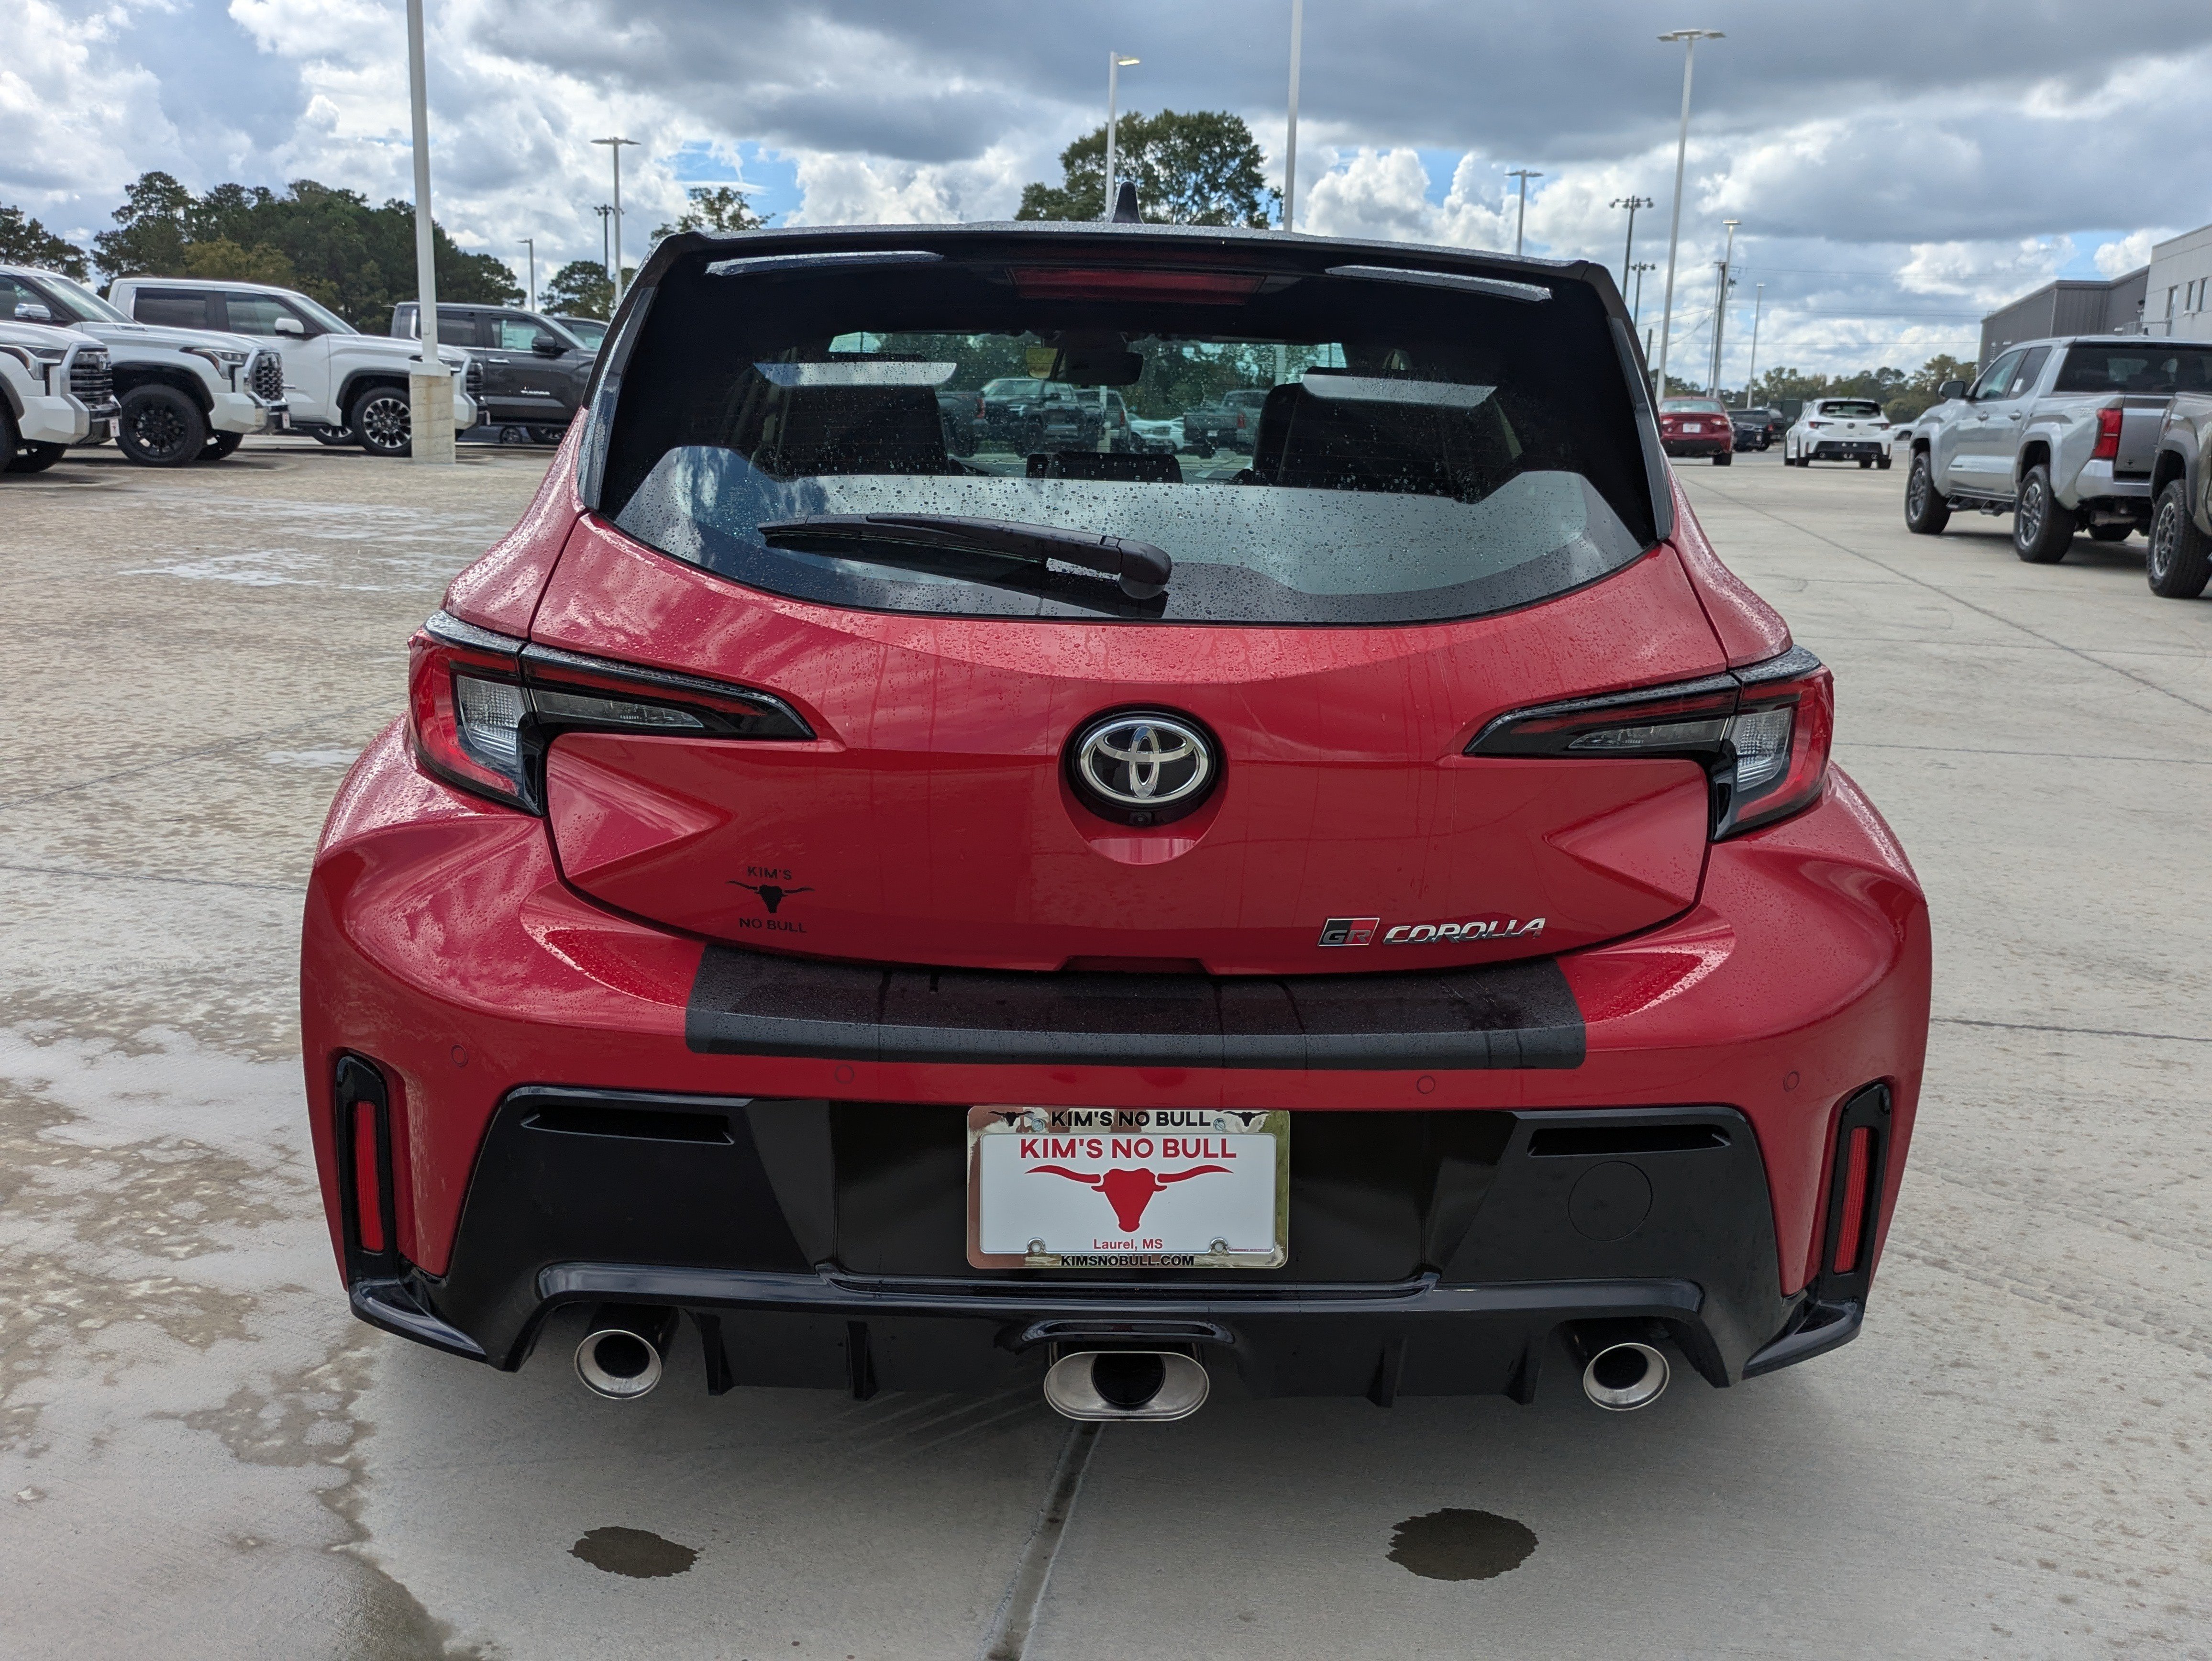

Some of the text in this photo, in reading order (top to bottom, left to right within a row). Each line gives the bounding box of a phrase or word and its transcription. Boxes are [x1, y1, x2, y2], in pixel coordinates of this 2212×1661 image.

[747, 865, 792, 880] KIM'S
[739, 918, 807, 933] NO BULL
[1322, 918, 1546, 945] GR COROLLA
[1051, 1111, 1211, 1127] KIM'S NO BULL
[1020, 1138, 1237, 1158] KIM'S NO BULL
[1093, 1239, 1163, 1251] Laurel, MS
[1061, 1255, 1194, 1266] KIMSNOBULL.COM
